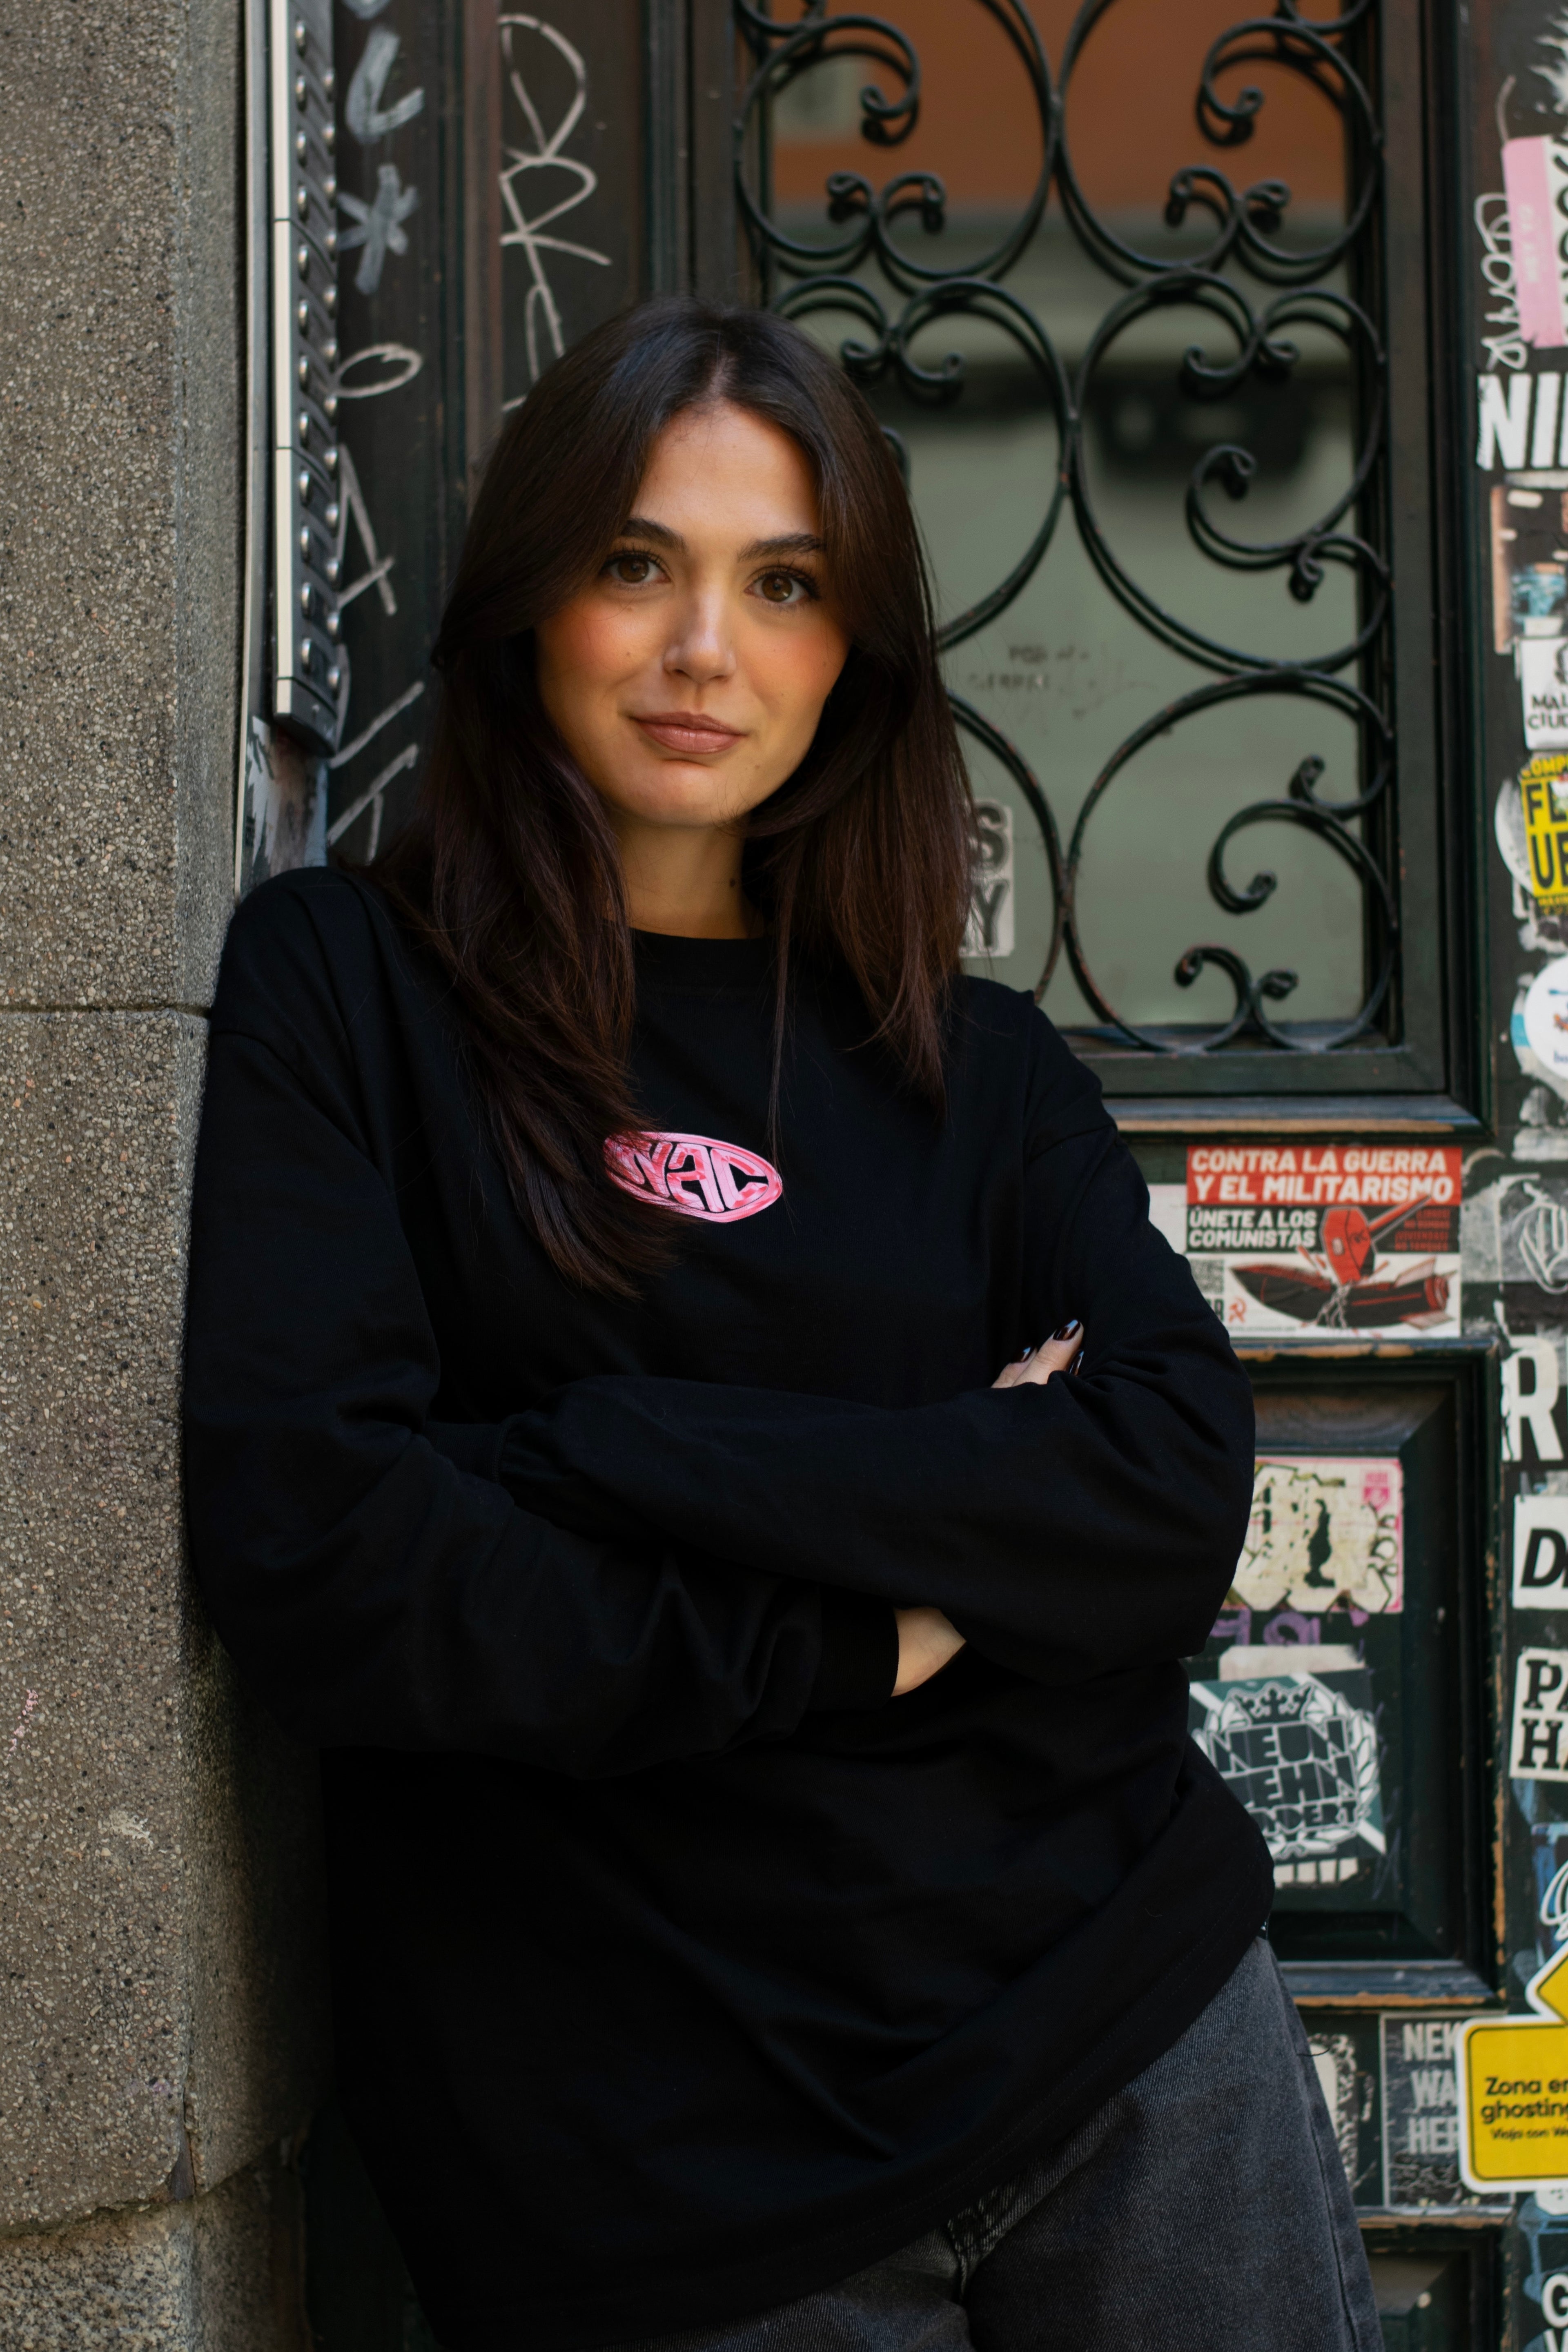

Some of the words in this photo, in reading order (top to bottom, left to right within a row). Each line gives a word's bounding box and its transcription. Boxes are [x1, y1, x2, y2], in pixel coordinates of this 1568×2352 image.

[1191, 1149, 1297, 1173] CONTRA
[1302, 1149, 1338, 1173] LA
[1343, 1149, 1447, 1174] GUERRA
[1194, 1175, 1215, 1202] Y
[1219, 1175, 1257, 1202] EL
[1262, 1175, 1454, 1204] MILITARISMO
[1257, 1209, 1274, 1228] A
[1276, 1209, 1317, 1228] LOS
[1188, 1228, 1316, 1248] COMUNISTAS
[1519, 1527, 1568, 1588] D
[1517, 1718, 1568, 1771] H
[1486, 2077, 1542, 2096] Zona
[1481, 2098, 1568, 2124] ghostin
